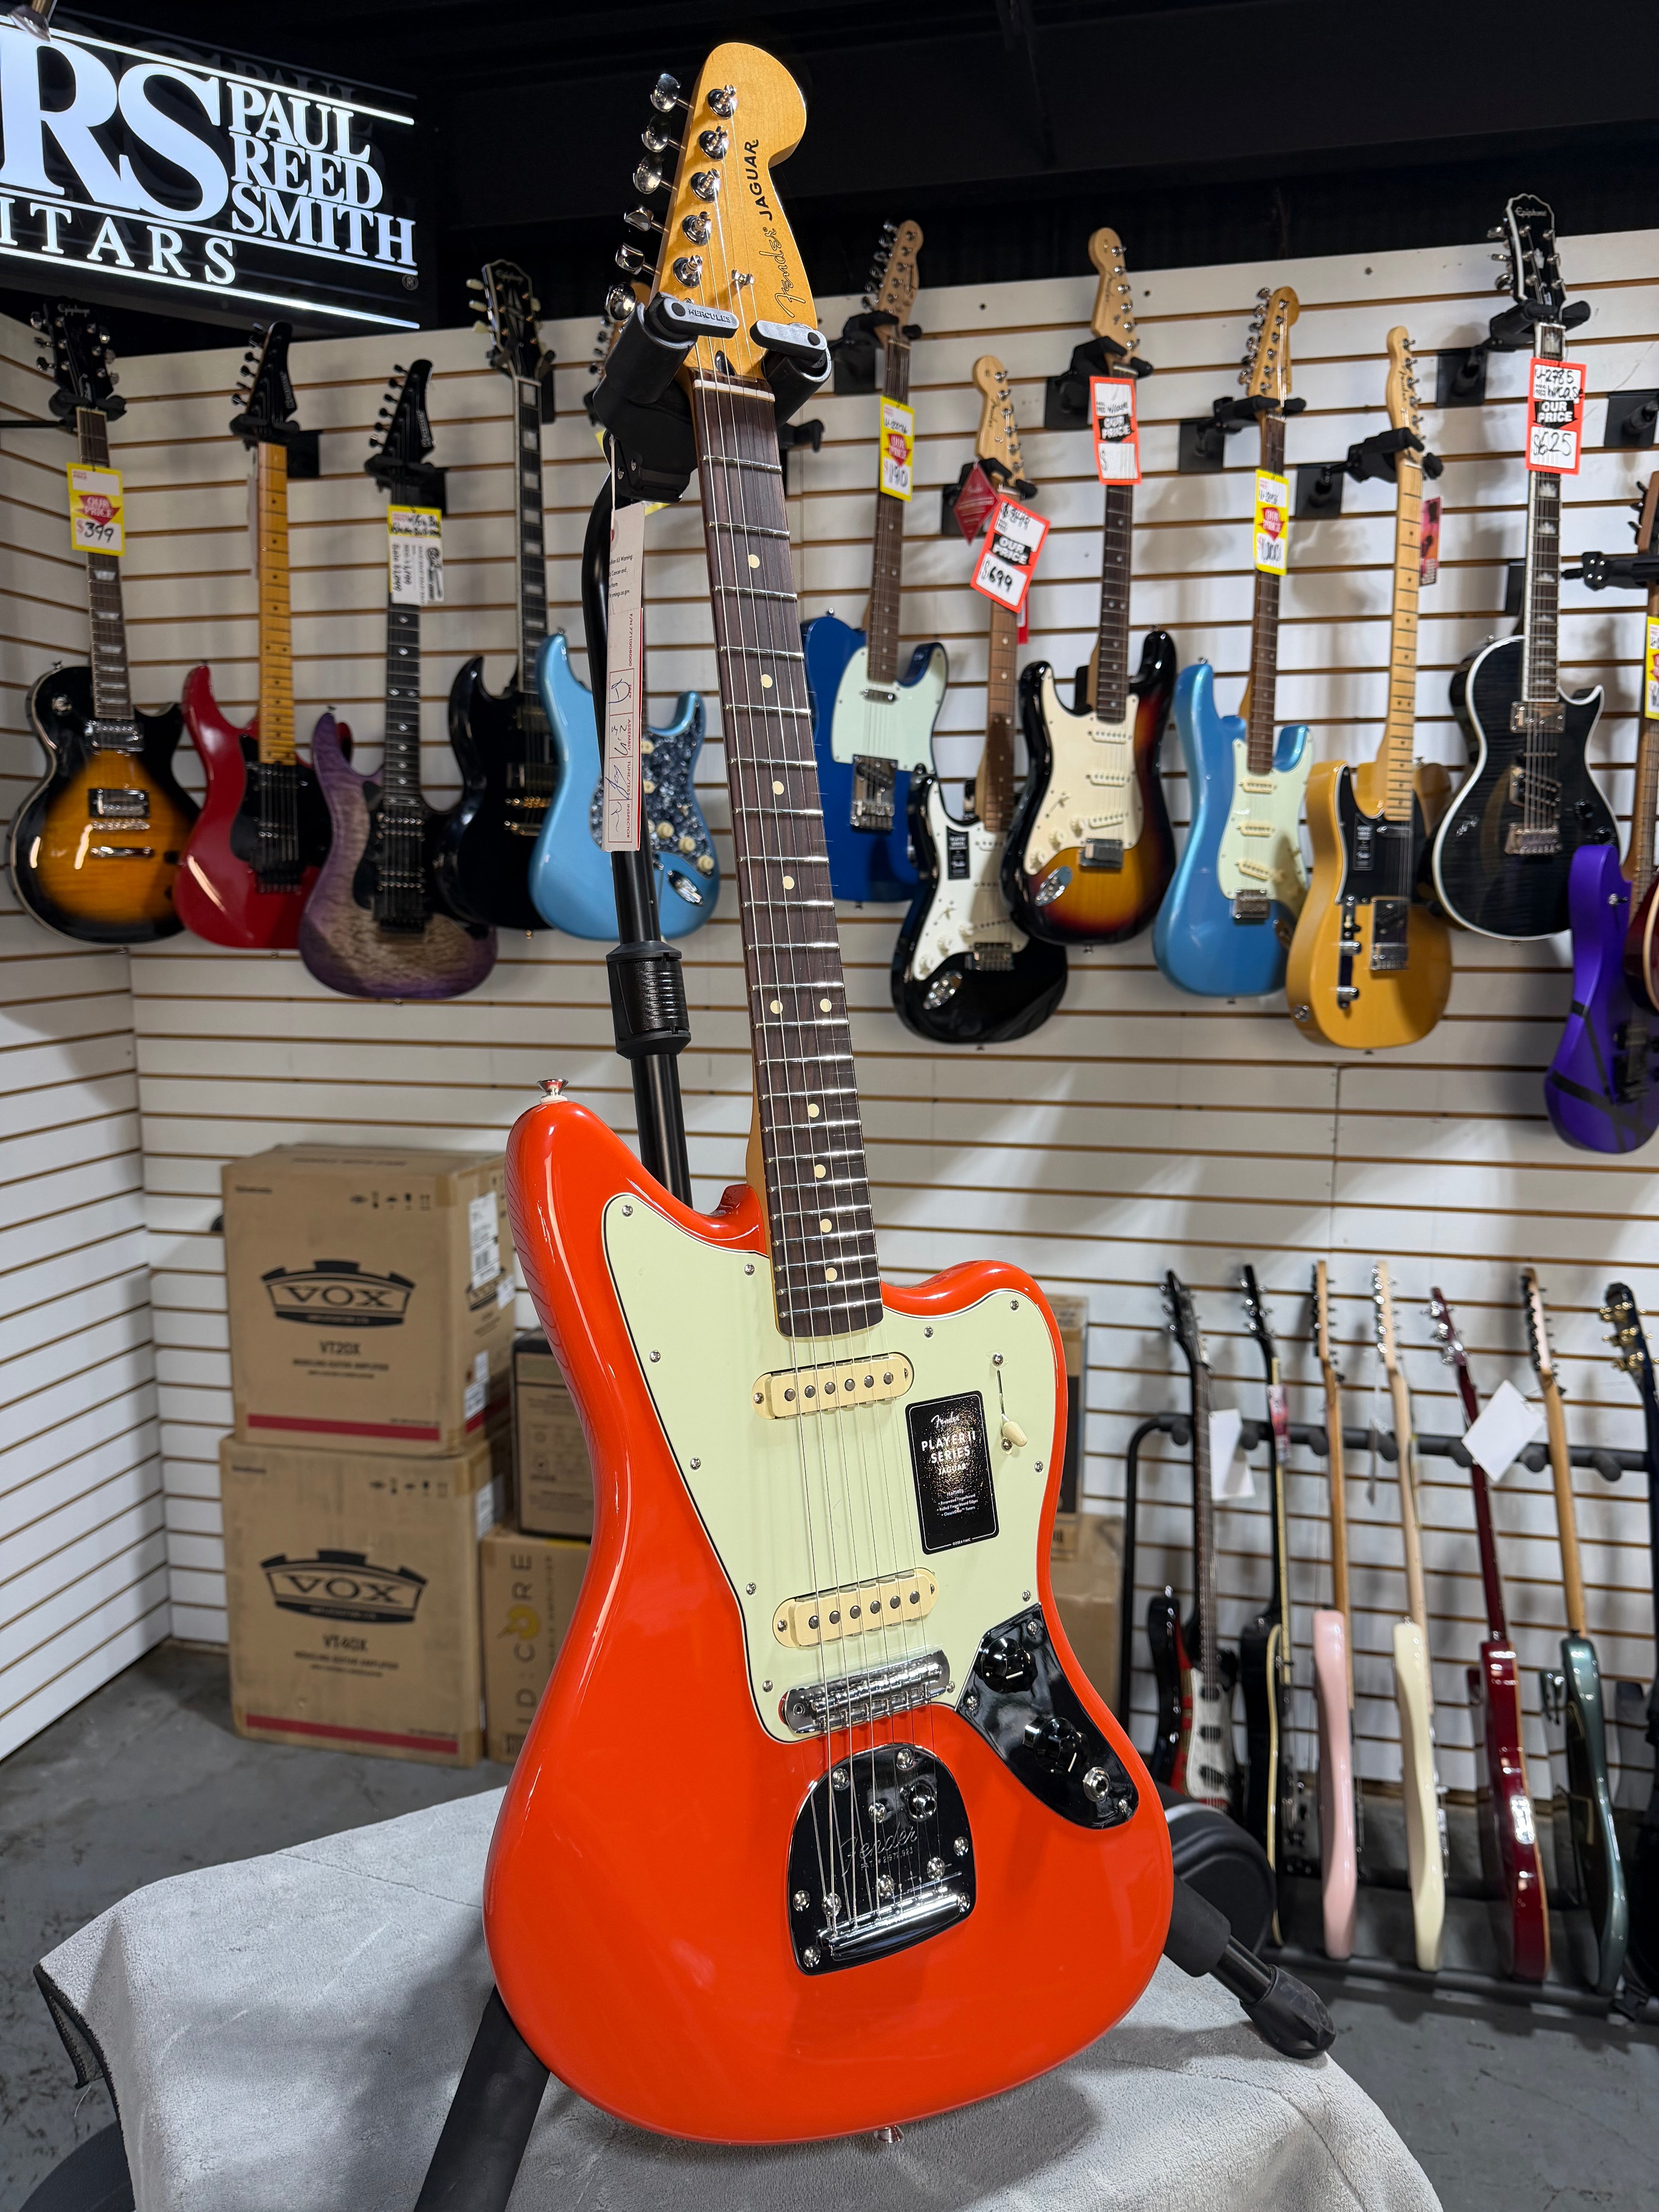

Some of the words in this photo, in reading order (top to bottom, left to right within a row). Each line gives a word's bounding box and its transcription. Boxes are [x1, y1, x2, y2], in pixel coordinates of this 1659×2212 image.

[226, 81, 371, 163] PAUL
[229, 131, 383, 210] REED
[744, 139, 773, 221] JAGUAR
[231, 185, 418, 267] SMITH
[759, 227, 805, 318] Fender
[688, 308, 732, 323] HERCULES
[1537, 411, 1573, 423] PRICE
[1542, 401, 1567, 412] OUR
[1103, 415, 1125, 428] OUR
[1101, 425, 1131, 440] PRICE
[1532, 431, 1572, 457] $625
[84, 506, 113, 518] PRICE
[87, 496, 110, 507] OUR
[77, 519, 114, 543] $399
[992, 544, 1029, 565] PRICE
[998, 536, 1026, 553] OUR
[282, 1284, 394, 1310] VOX
[931, 1411, 960, 1429] Fender
[921, 1431, 966, 1452] PLAYER
[968, 1430, 976, 1442] II
[930, 1445, 971, 1464] SERIES
[938, 1462, 967, 1476] JAGUAR
[285, 1575, 404, 1604] VOX
[840, 1823, 918, 1877] Fender
